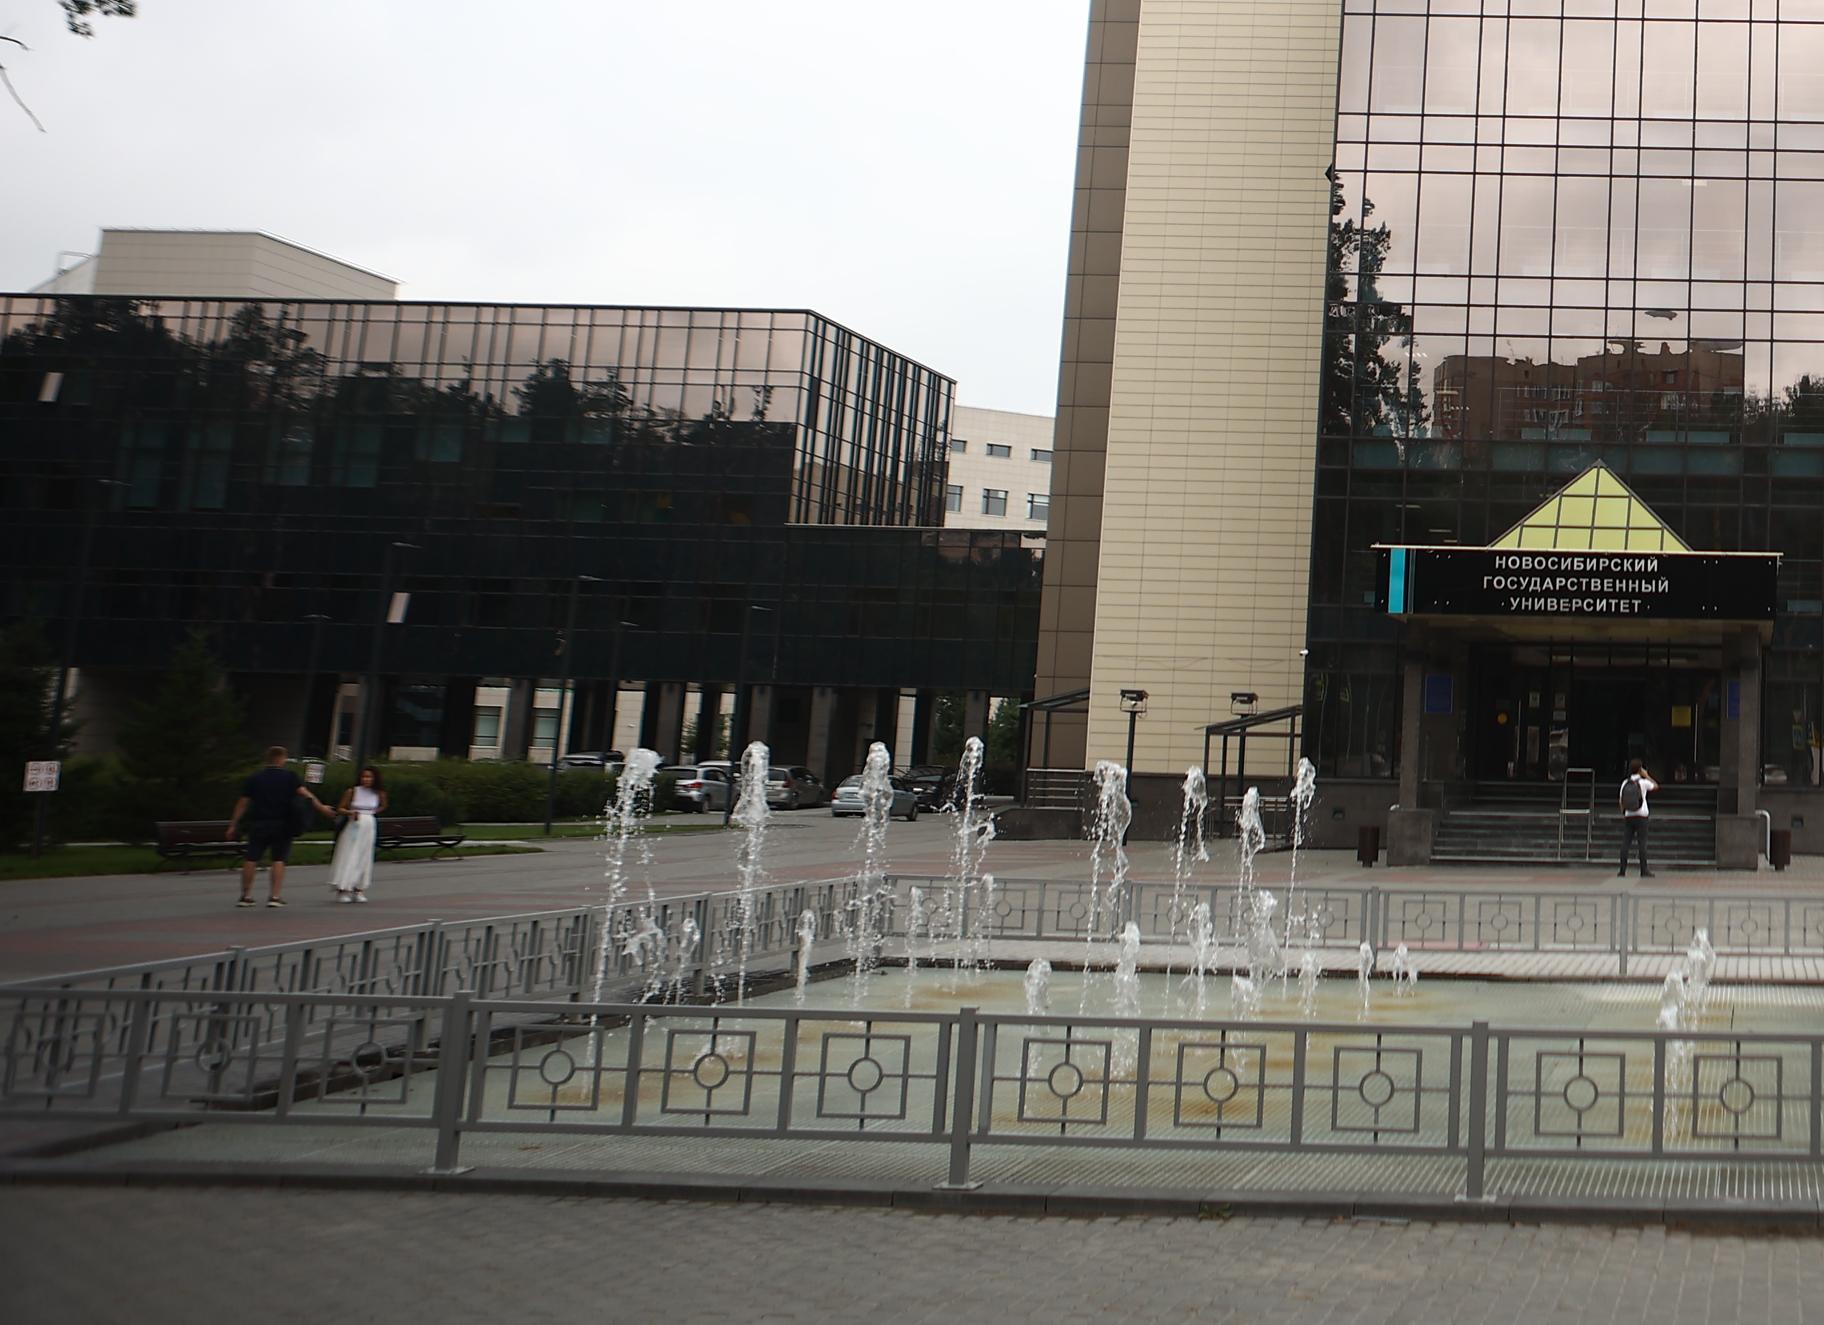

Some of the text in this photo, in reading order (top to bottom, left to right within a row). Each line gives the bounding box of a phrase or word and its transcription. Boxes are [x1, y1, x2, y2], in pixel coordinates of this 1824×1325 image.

[1494, 555, 1659, 573] НОВОСИБИРСКИЙ
[1482, 575, 1670, 593] ГОСУДАРСТВЕННЫЙ
[1509, 596, 1643, 613] УНИВЕРСИТЕТ
